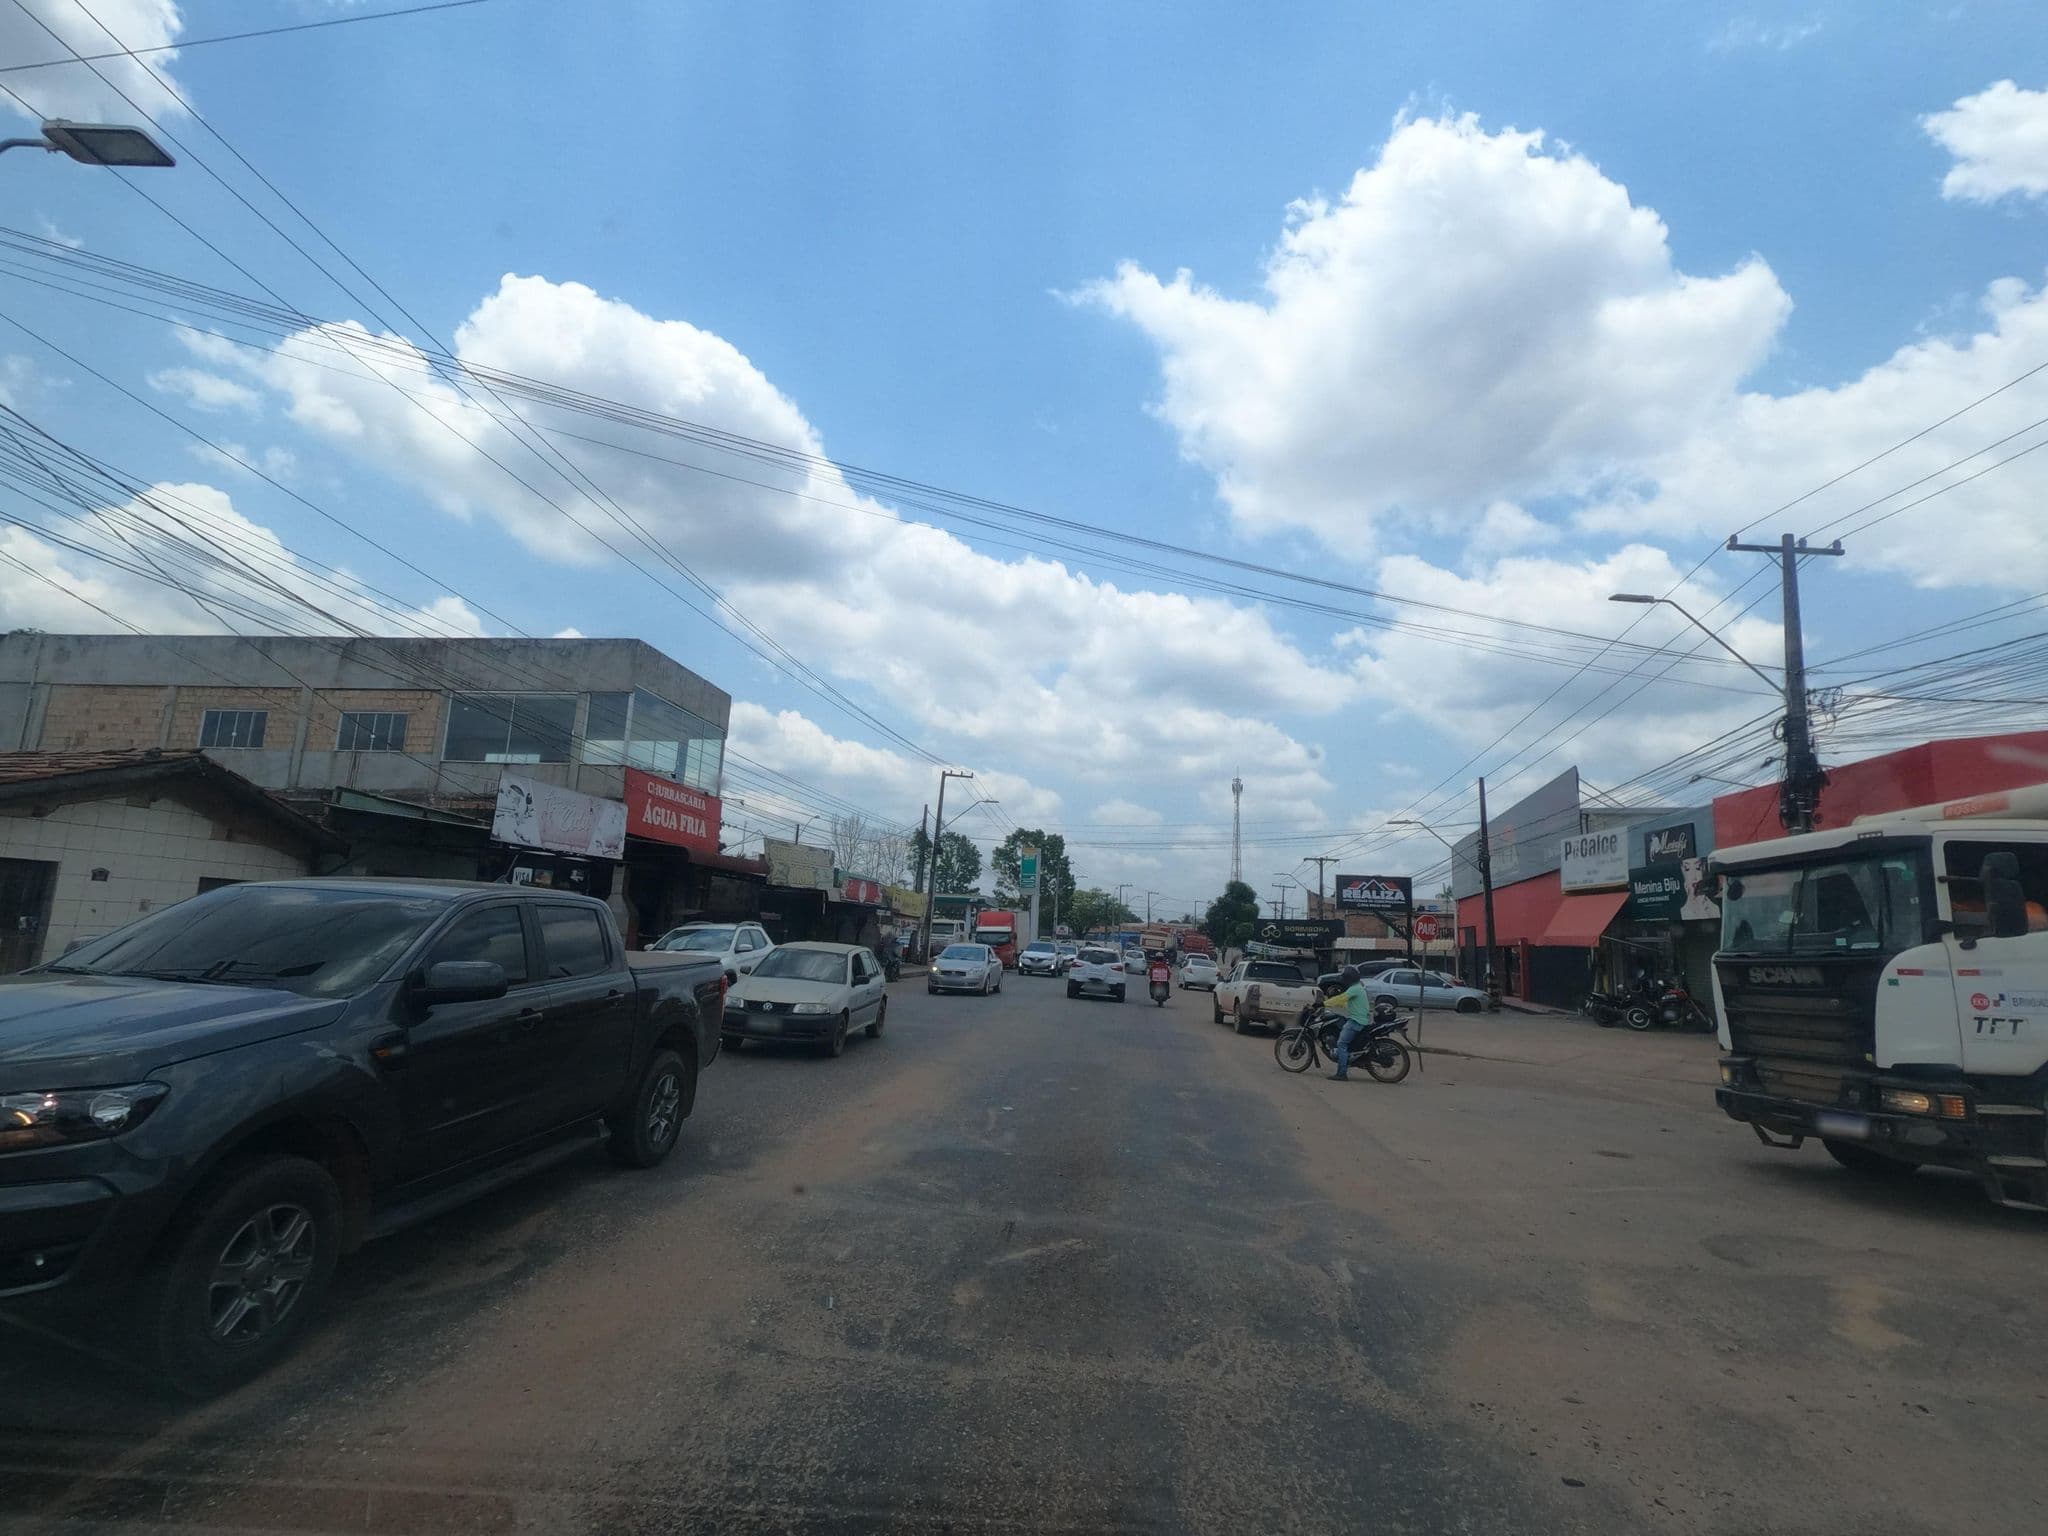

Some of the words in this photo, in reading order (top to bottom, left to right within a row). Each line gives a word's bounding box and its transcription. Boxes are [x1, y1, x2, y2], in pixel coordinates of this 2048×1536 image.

[647, 781, 706, 811] CHURRASCARIA
[642, 799, 678, 831] ÁGUA
[679, 813, 707, 838] FRIA
[1342, 888, 1406, 901] REALIZA
[1634, 880, 1663, 895] Menina
[1663, 877, 1681, 895] Biju
[1417, 921, 1437, 936] PARE
[1748, 966, 1823, 985] SCANIA
[1973, 1016, 2025, 1036] TFT
